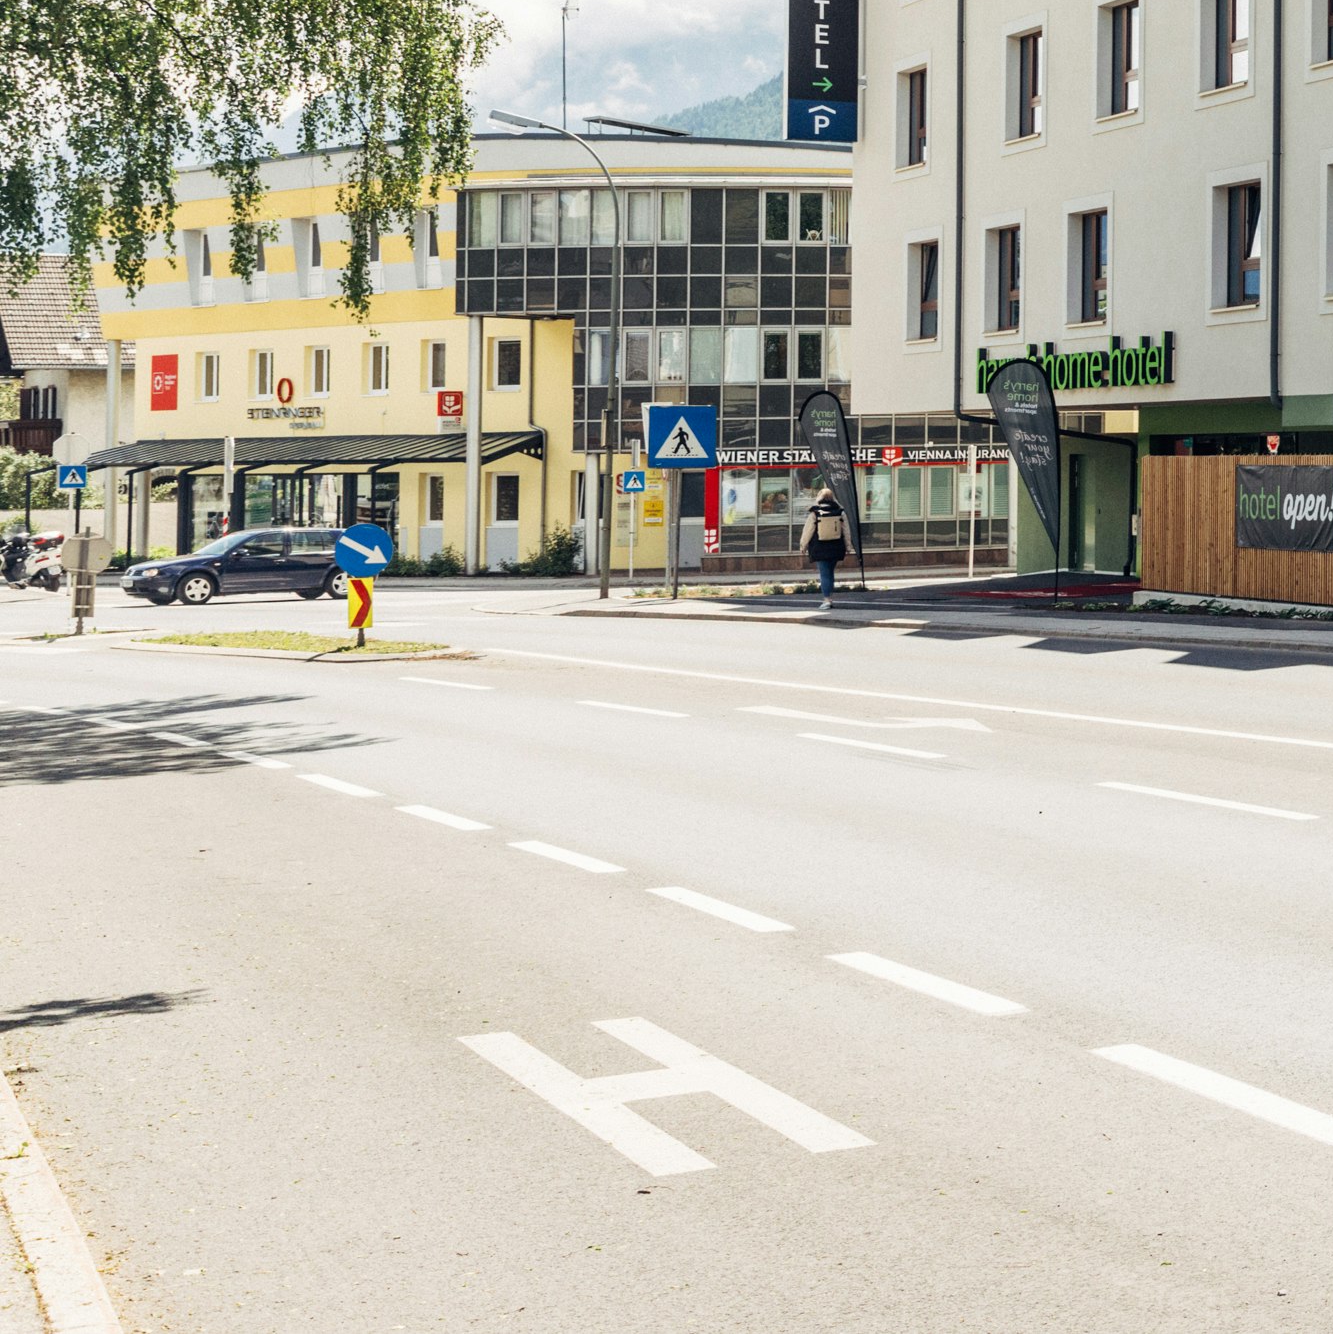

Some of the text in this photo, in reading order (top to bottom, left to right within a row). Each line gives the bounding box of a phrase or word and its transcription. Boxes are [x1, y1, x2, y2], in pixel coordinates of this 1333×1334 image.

[814, 115, 831, 135] P
[1043, 342, 1104, 391] home
[1109, 331, 1174, 387] hotel
[715, 450, 779, 463] WIENER
[907, 448, 1010, 461] VIENNA INURANC
[1239, 484, 1281, 521] hotel
[456, 1016, 879, 1177] H
